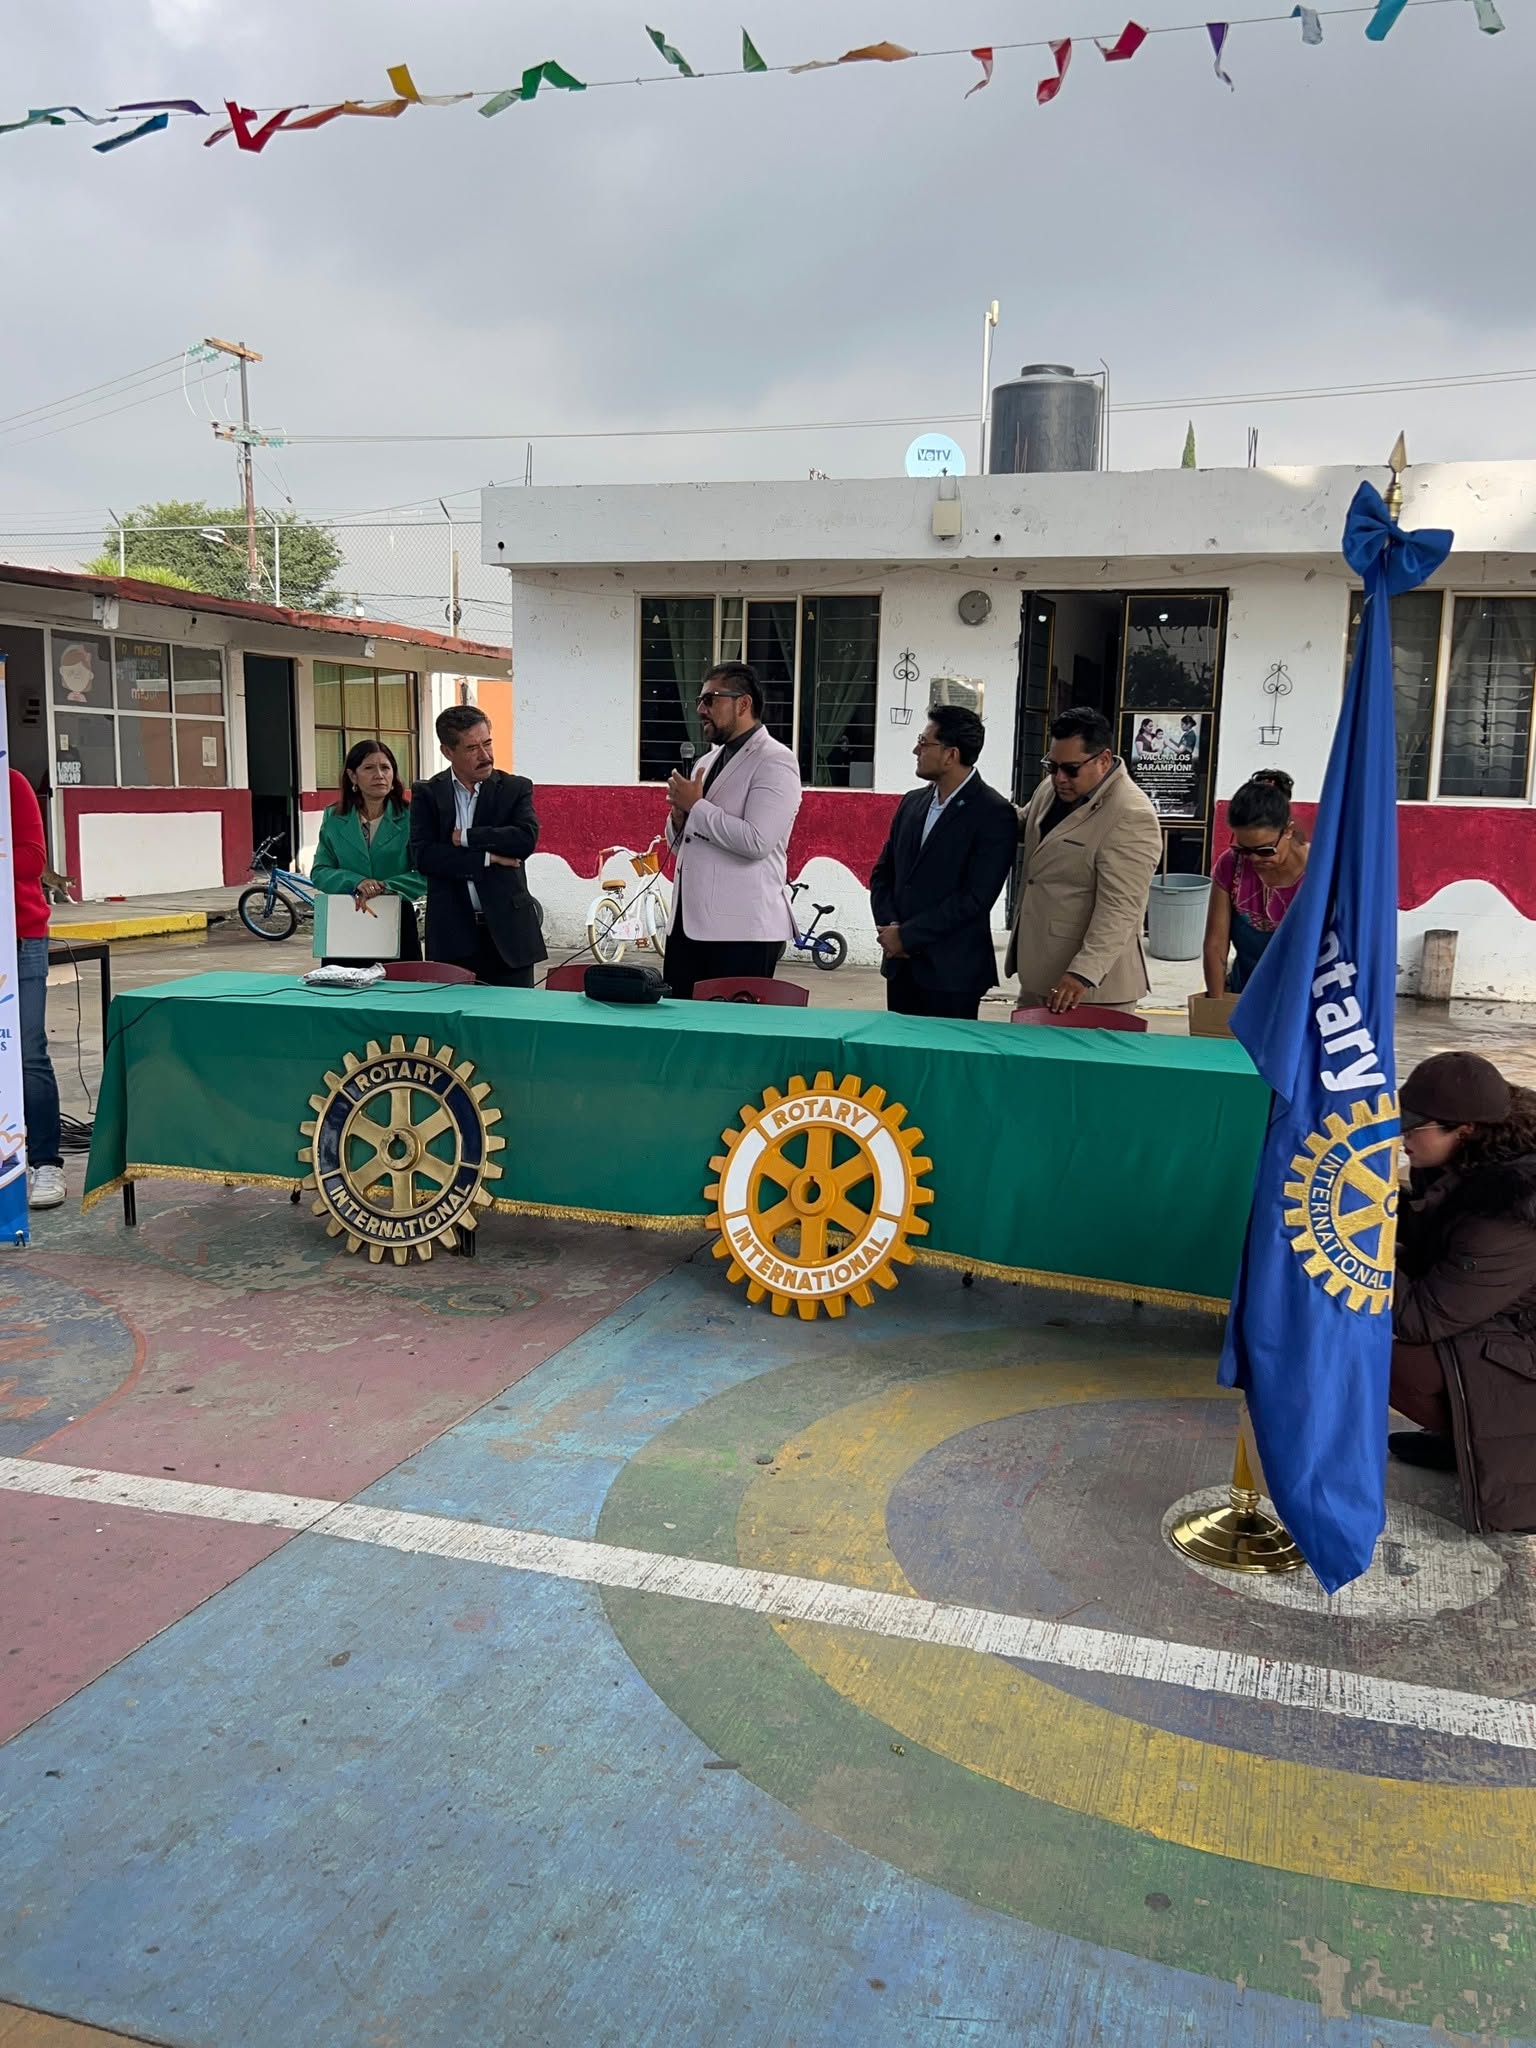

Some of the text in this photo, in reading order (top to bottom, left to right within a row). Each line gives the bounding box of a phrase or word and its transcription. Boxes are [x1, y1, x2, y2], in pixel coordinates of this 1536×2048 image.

[917, 449, 951, 461] VeTV
[354, 1061, 442, 1092] ROTARY
[770, 1098, 869, 1130] ROTARY
[329, 1183, 472, 1239] INTERNATIONAL
[1310, 1152, 1388, 1290] INTERNATIONAL
[732, 1226, 889, 1292] INTERNATIONAL
